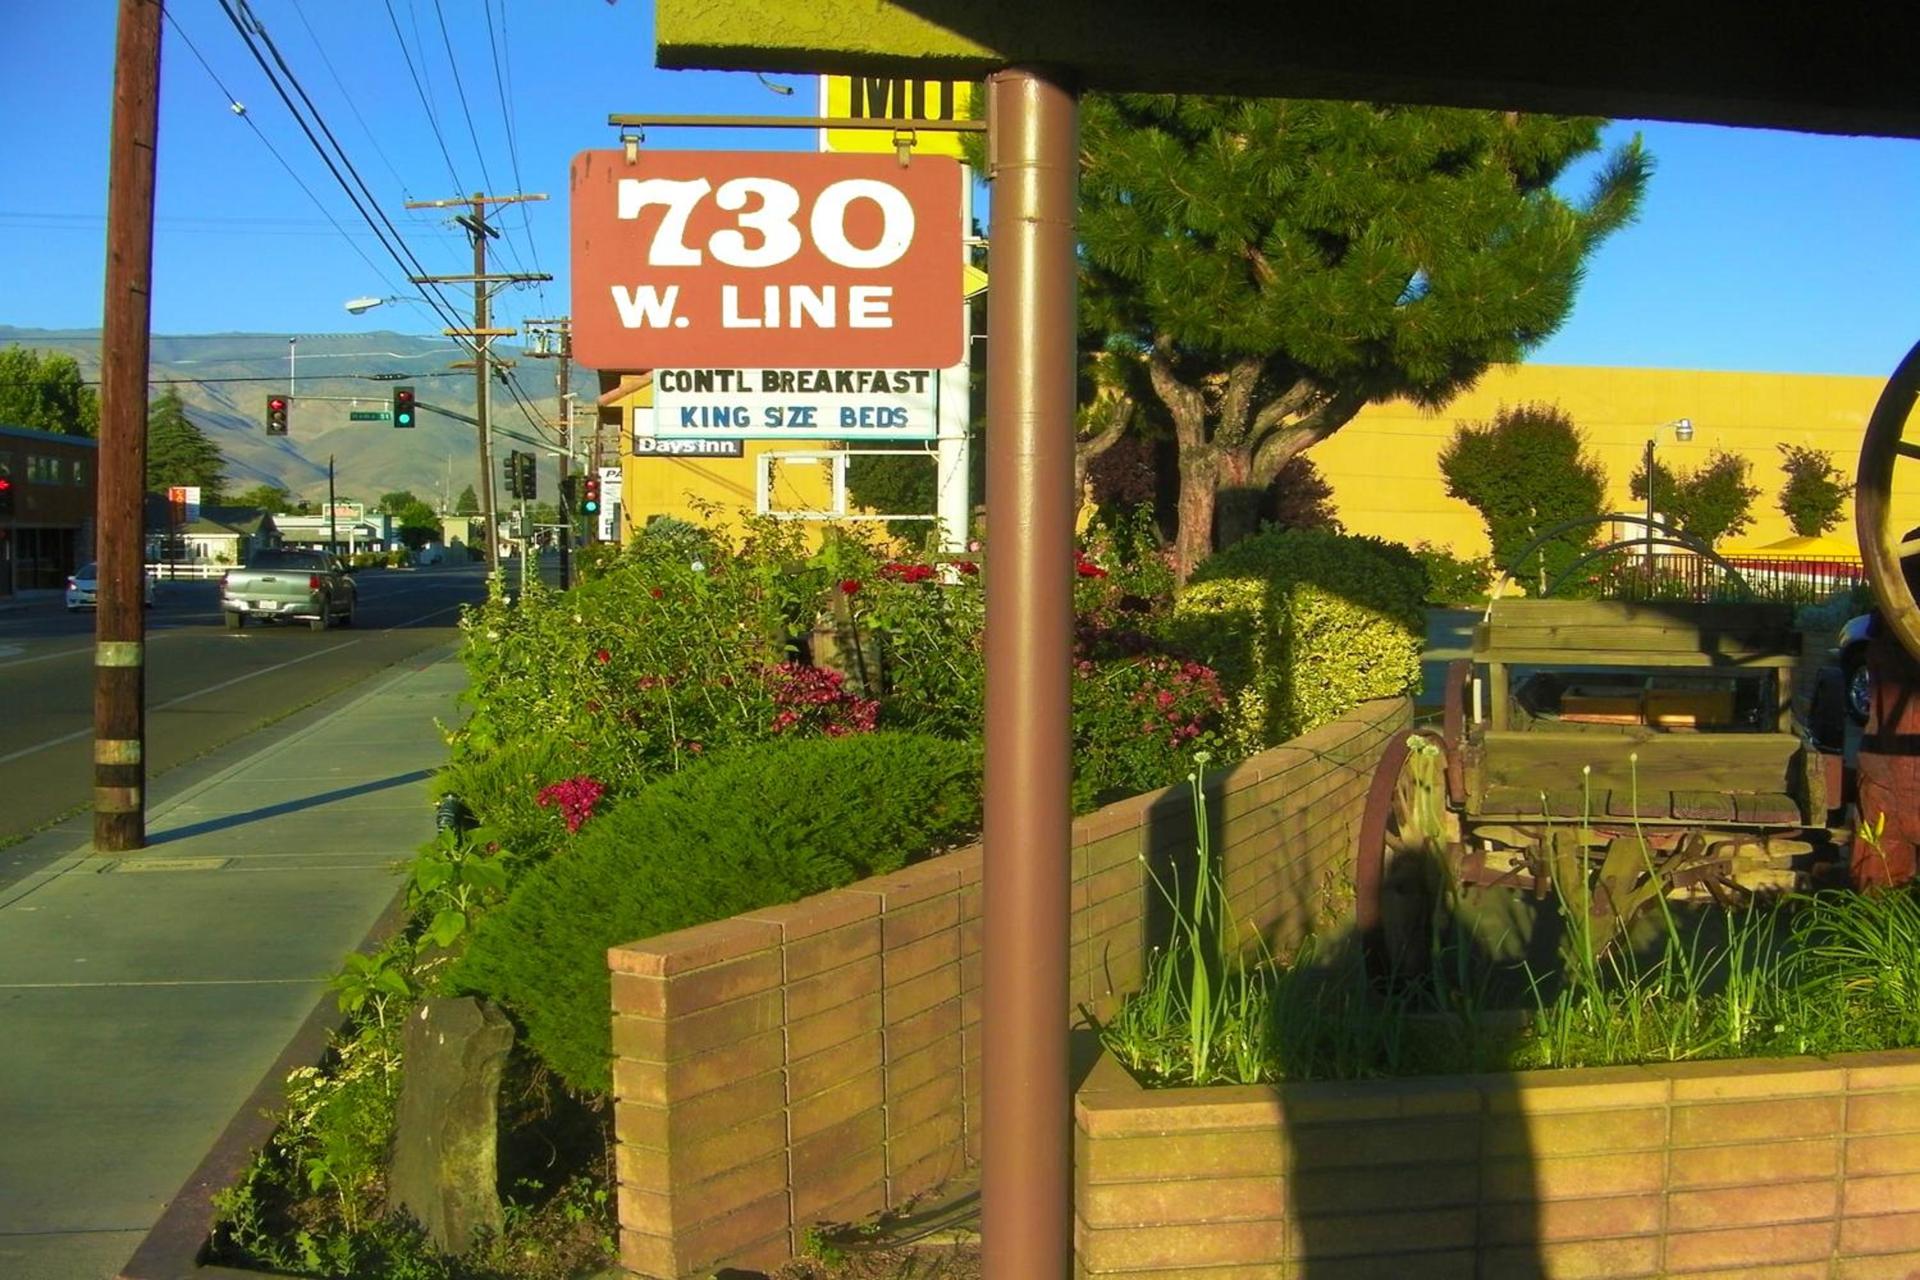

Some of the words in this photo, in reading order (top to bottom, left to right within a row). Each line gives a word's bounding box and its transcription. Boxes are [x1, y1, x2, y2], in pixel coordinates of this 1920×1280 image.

[617, 177, 915, 269] 730
[610, 285, 690, 329] W.
[722, 285, 893, 329] LINE
[659, 369, 753, 393] CONTL
[761, 369, 930, 394] BREAKFAST
[680, 406, 751, 428] KING
[764, 406, 818, 428] SIZE
[840, 406, 909, 428] BEDS
